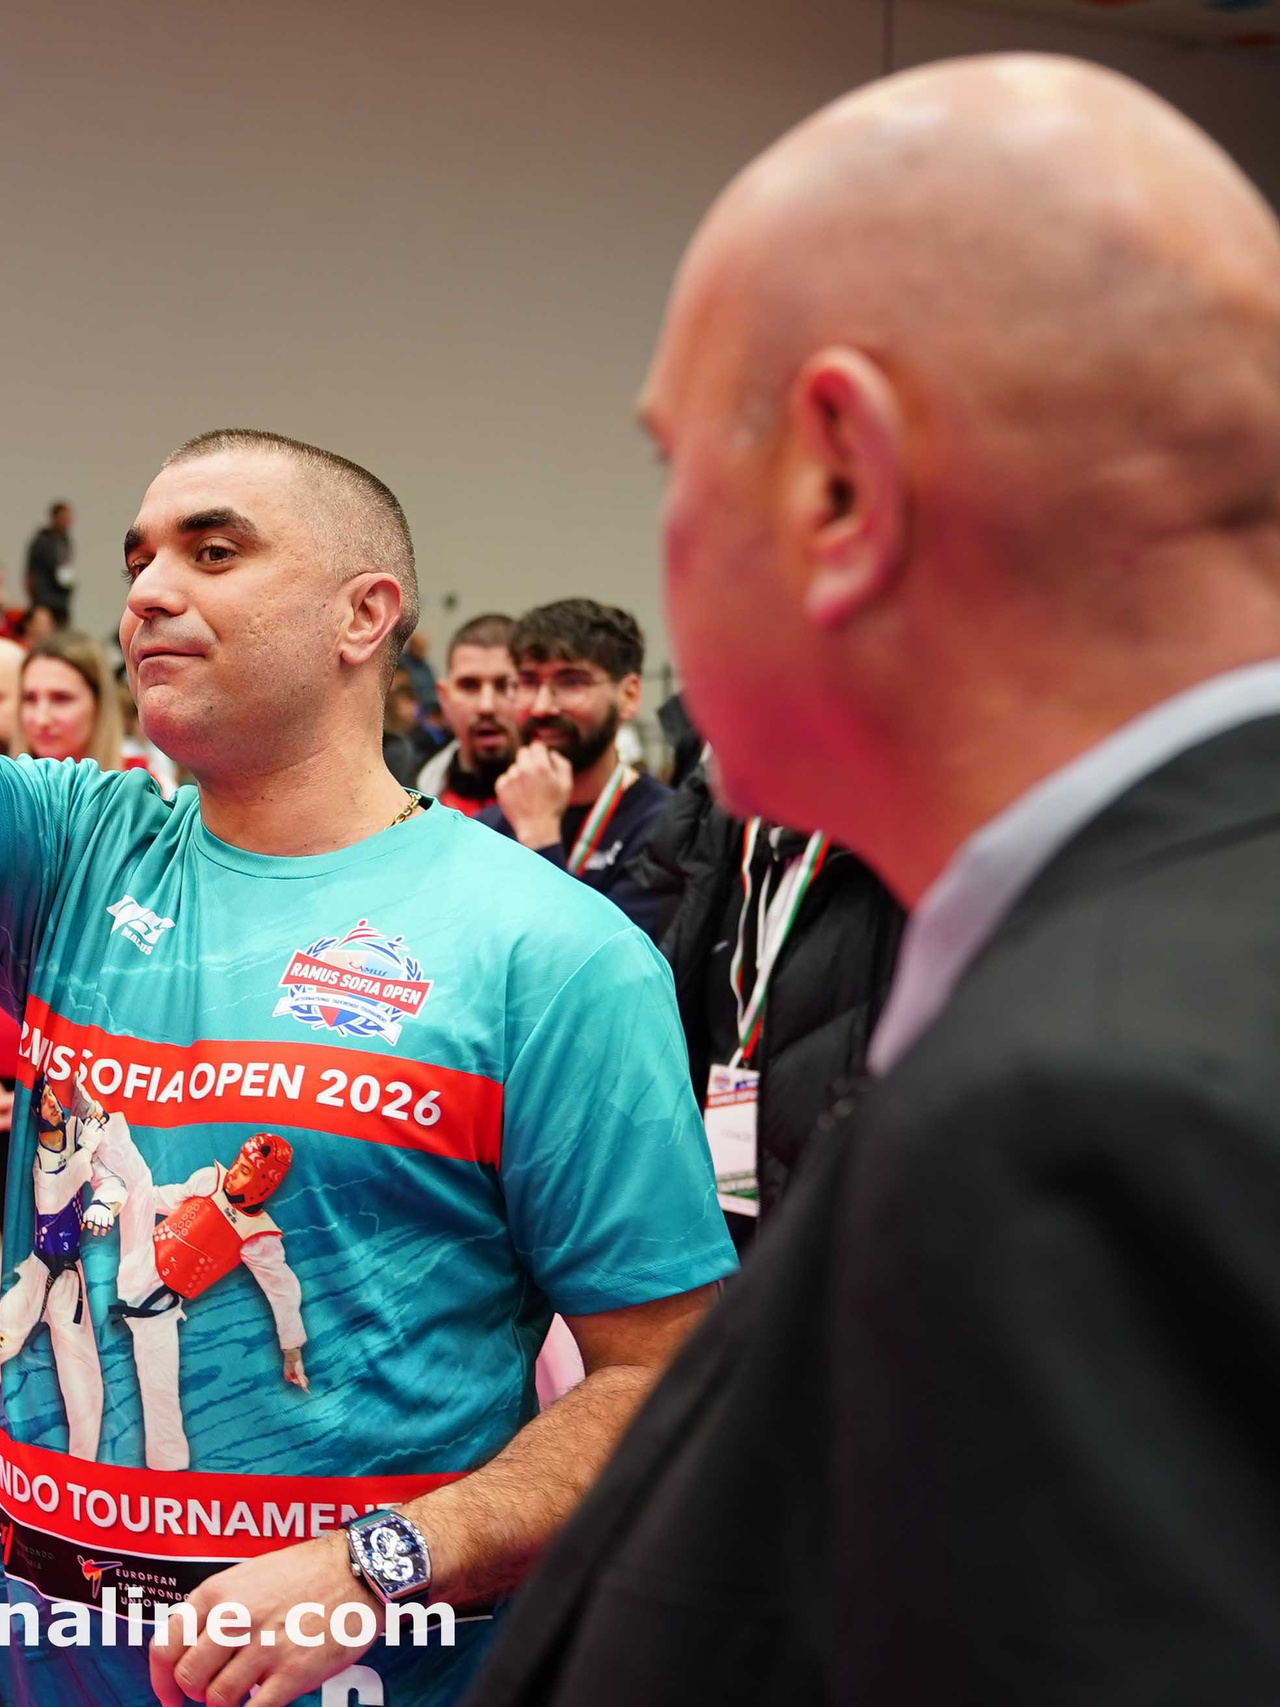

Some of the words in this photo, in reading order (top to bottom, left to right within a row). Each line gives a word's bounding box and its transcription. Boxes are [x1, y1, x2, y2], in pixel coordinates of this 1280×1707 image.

[290, 962, 340, 986] RAMUS
[339, 973, 381, 996] SOFIA
[382, 984, 422, 1006] OPEN
[188, 1062, 305, 1100] OPEN
[316, 1068, 441, 1126] 2026
[66, 1482, 403, 1537] TOURNAMEN
[116, 1568, 177, 1586] EUROPEAN
